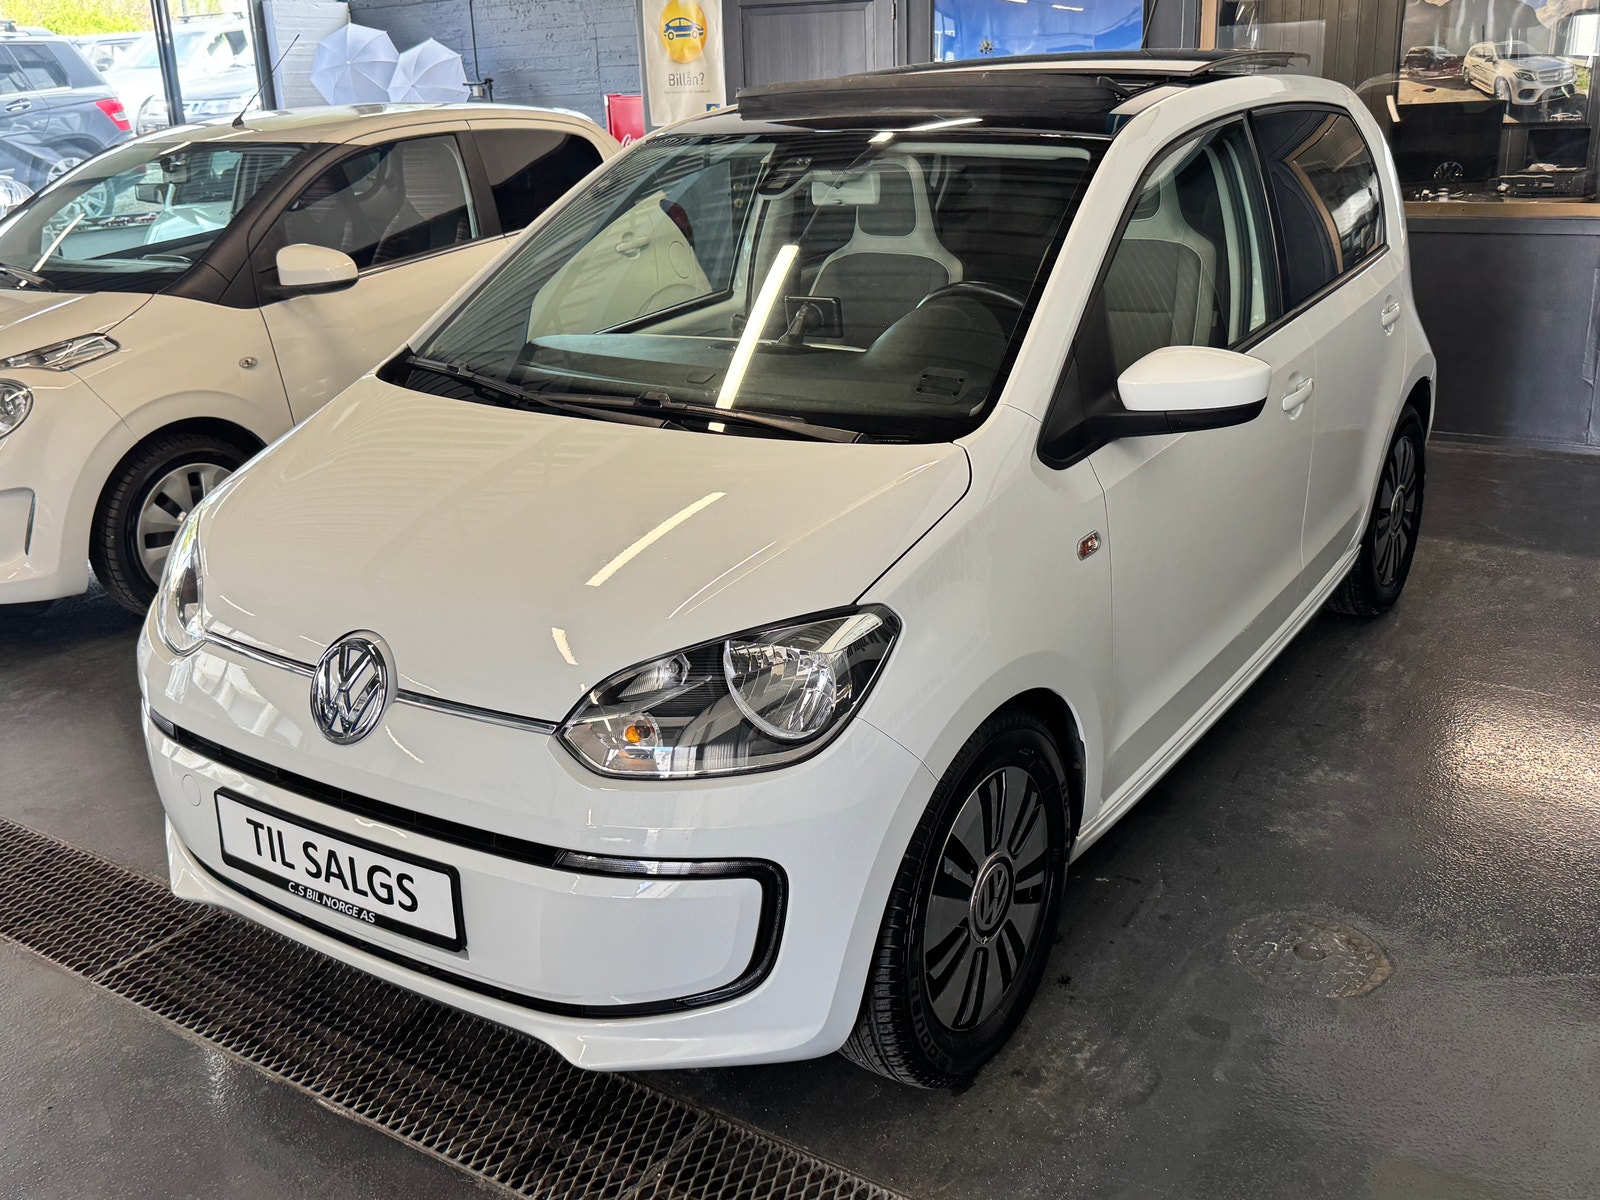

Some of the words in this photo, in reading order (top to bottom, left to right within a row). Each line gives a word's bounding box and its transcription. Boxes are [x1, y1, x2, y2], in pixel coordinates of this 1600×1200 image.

[668, 72, 705, 87] Billån?
[246, 817, 296, 870] TIL
[302, 840, 419, 913] SALGS
[288, 881, 305, 896] C.S
[306, 888, 321, 903] BIL
[322, 895, 359, 918] NORGE
[360, 909, 376, 924] AS
